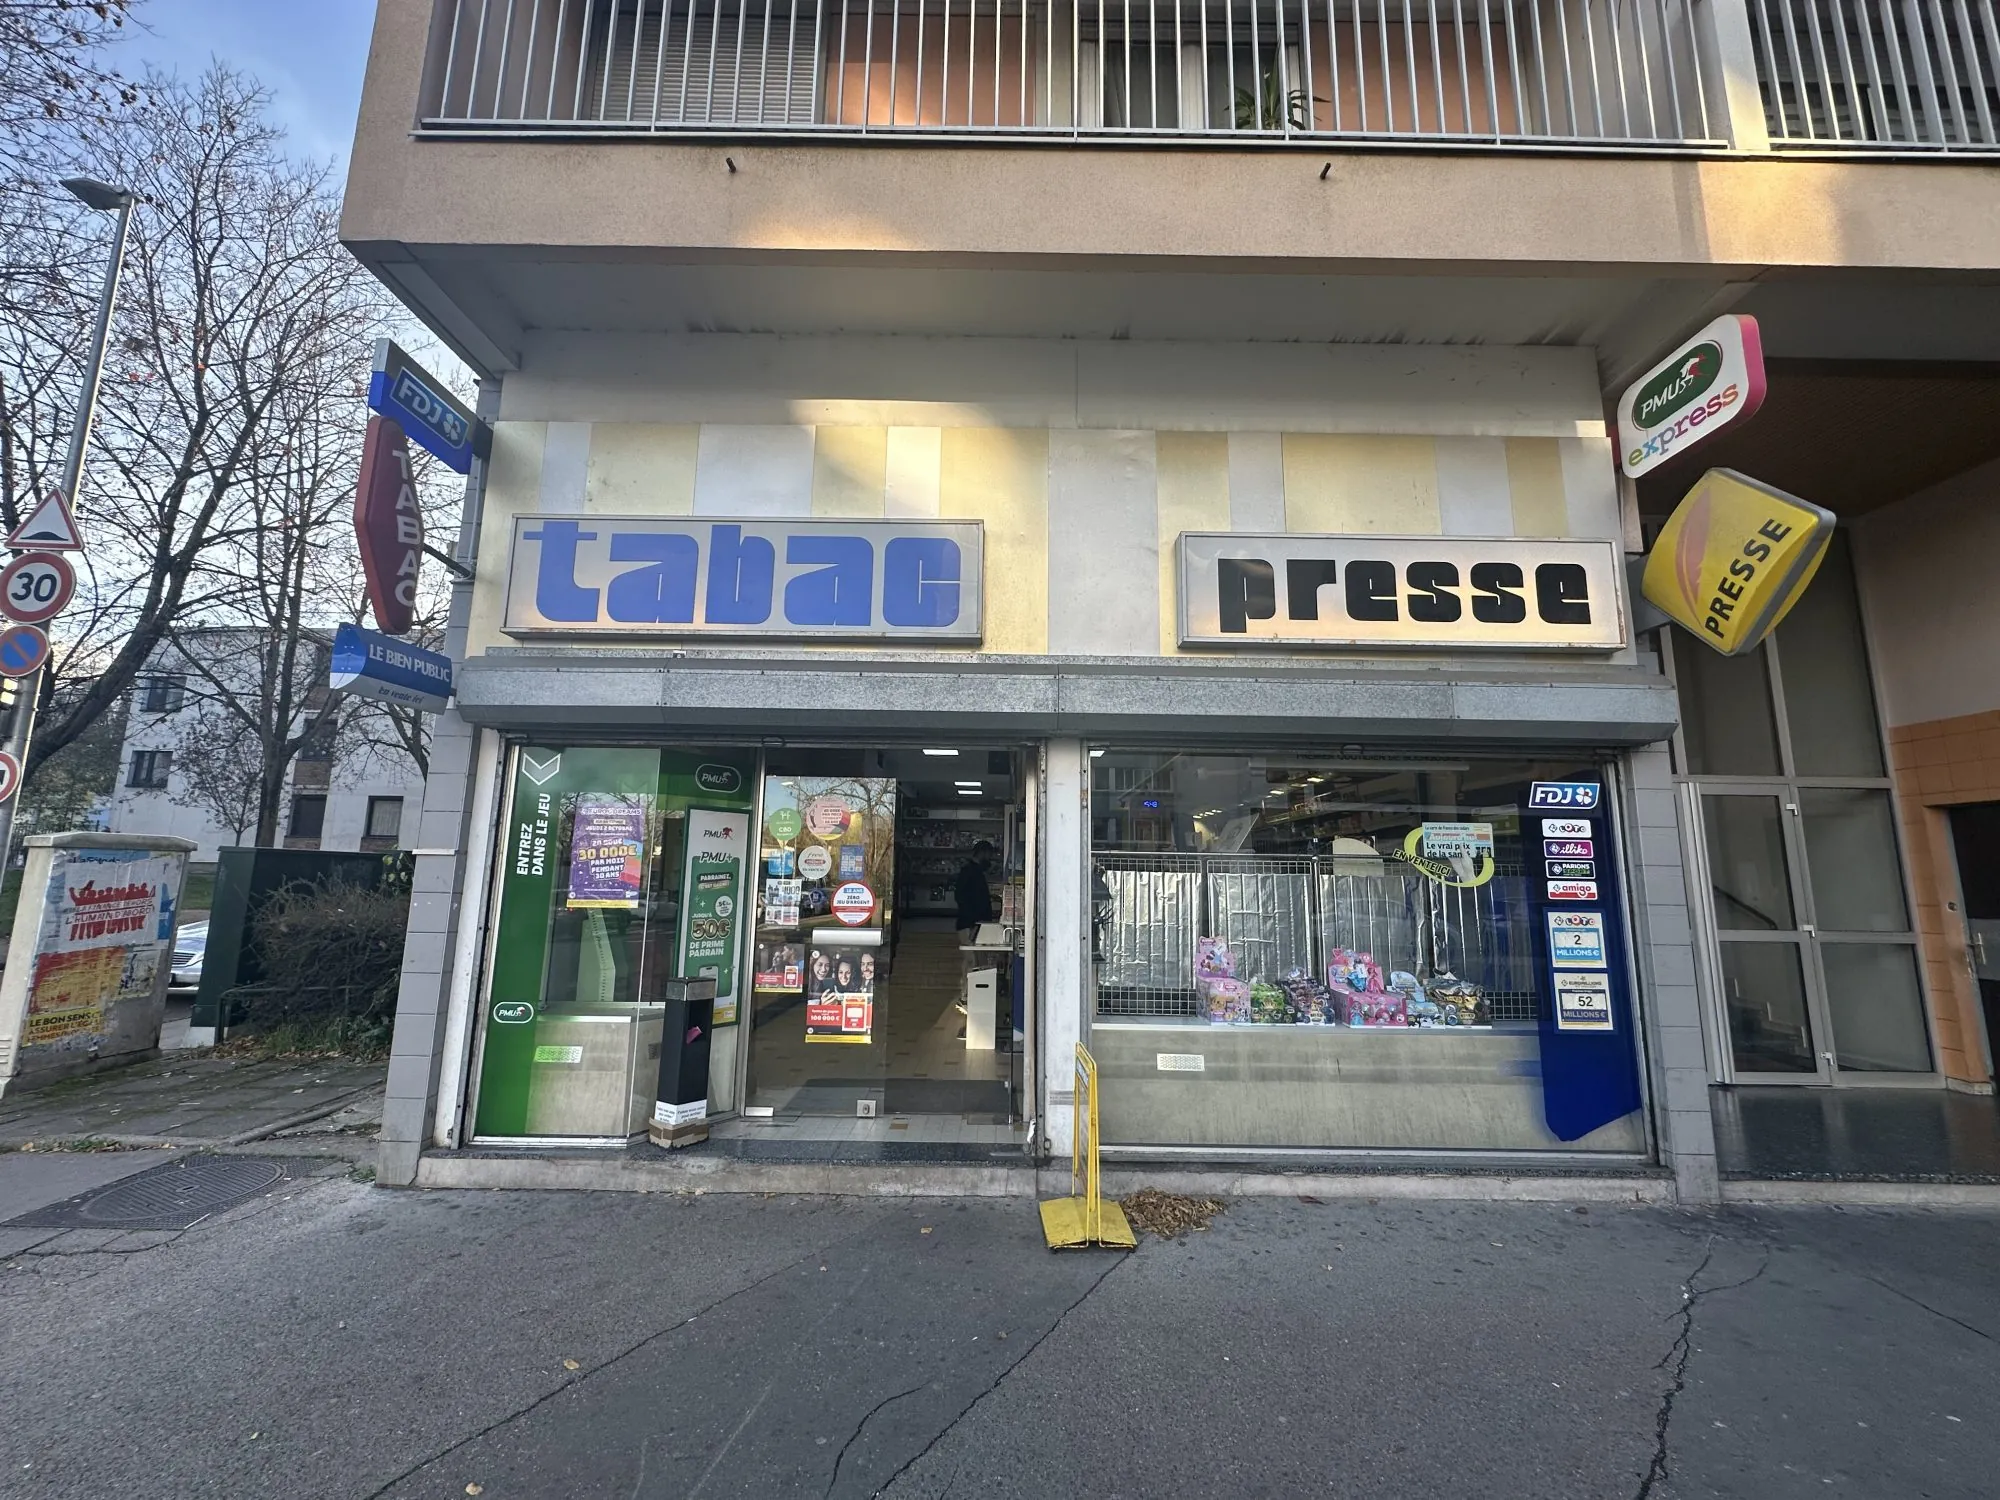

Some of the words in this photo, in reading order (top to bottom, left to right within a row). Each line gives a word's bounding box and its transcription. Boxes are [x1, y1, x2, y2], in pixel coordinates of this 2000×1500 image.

[398, 377, 443, 425] FDJ
[1641, 383, 1683, 420] PMU
[1628, 383, 1739, 468] express
[392, 449, 421, 608] TABAC
[522, 520, 961, 628] tabac
[1704, 518, 1793, 640] PRESSE
[11, 572, 58, 602] 30
[1217, 557, 1592, 634] presse
[368, 643, 384, 662] LE
[385, 649, 413, 671] BIEN
[413, 658, 450, 683] PUBLIC
[701, 773, 721, 784] PMU
[1534, 786, 1573, 804] FDJ
[537, 793, 551, 817] JEU
[535, 819, 548, 835] LE
[1559, 823, 1587, 833] LOTO
[703, 829, 723, 839] PMU
[516, 822, 533, 876] ENTREZ
[578, 848, 597, 860] 30
[600, 845, 637, 859] 000€
[1426, 842, 1435, 850] Le
[1455, 843, 1471, 851] pix
[1560, 843, 1588, 855] illiko
[531, 837, 547, 876] DANS
[1427, 850, 1437, 858] de
[1439, 850, 1446, 858] la
[605, 857, 625, 865] MOIS
[1393, 849, 1406, 860] EN
[1408, 854, 1436, 871] VENTE
[1436, 866, 1451, 876] ICI
[591, 864, 624, 874] PENDANT
[605, 871, 620, 879] ANS
[1562, 883, 1592, 897] amigo
[1565, 914, 1596, 926] LOTO
[689, 941, 700, 949] DE
[701, 940, 725, 949] PRIME
[1573, 934, 1582, 945] 2
[688, 948, 724, 958] PARRAIN
[1592, 949, 1600, 957] €
[1578, 996, 1594, 1007] 52
[498, 1009, 516, 1017] PMU
[1563, 1010, 1600, 1018] MILLIONS
[29, 1018, 42, 1027] LE
[43, 1015, 66, 1026] BON
